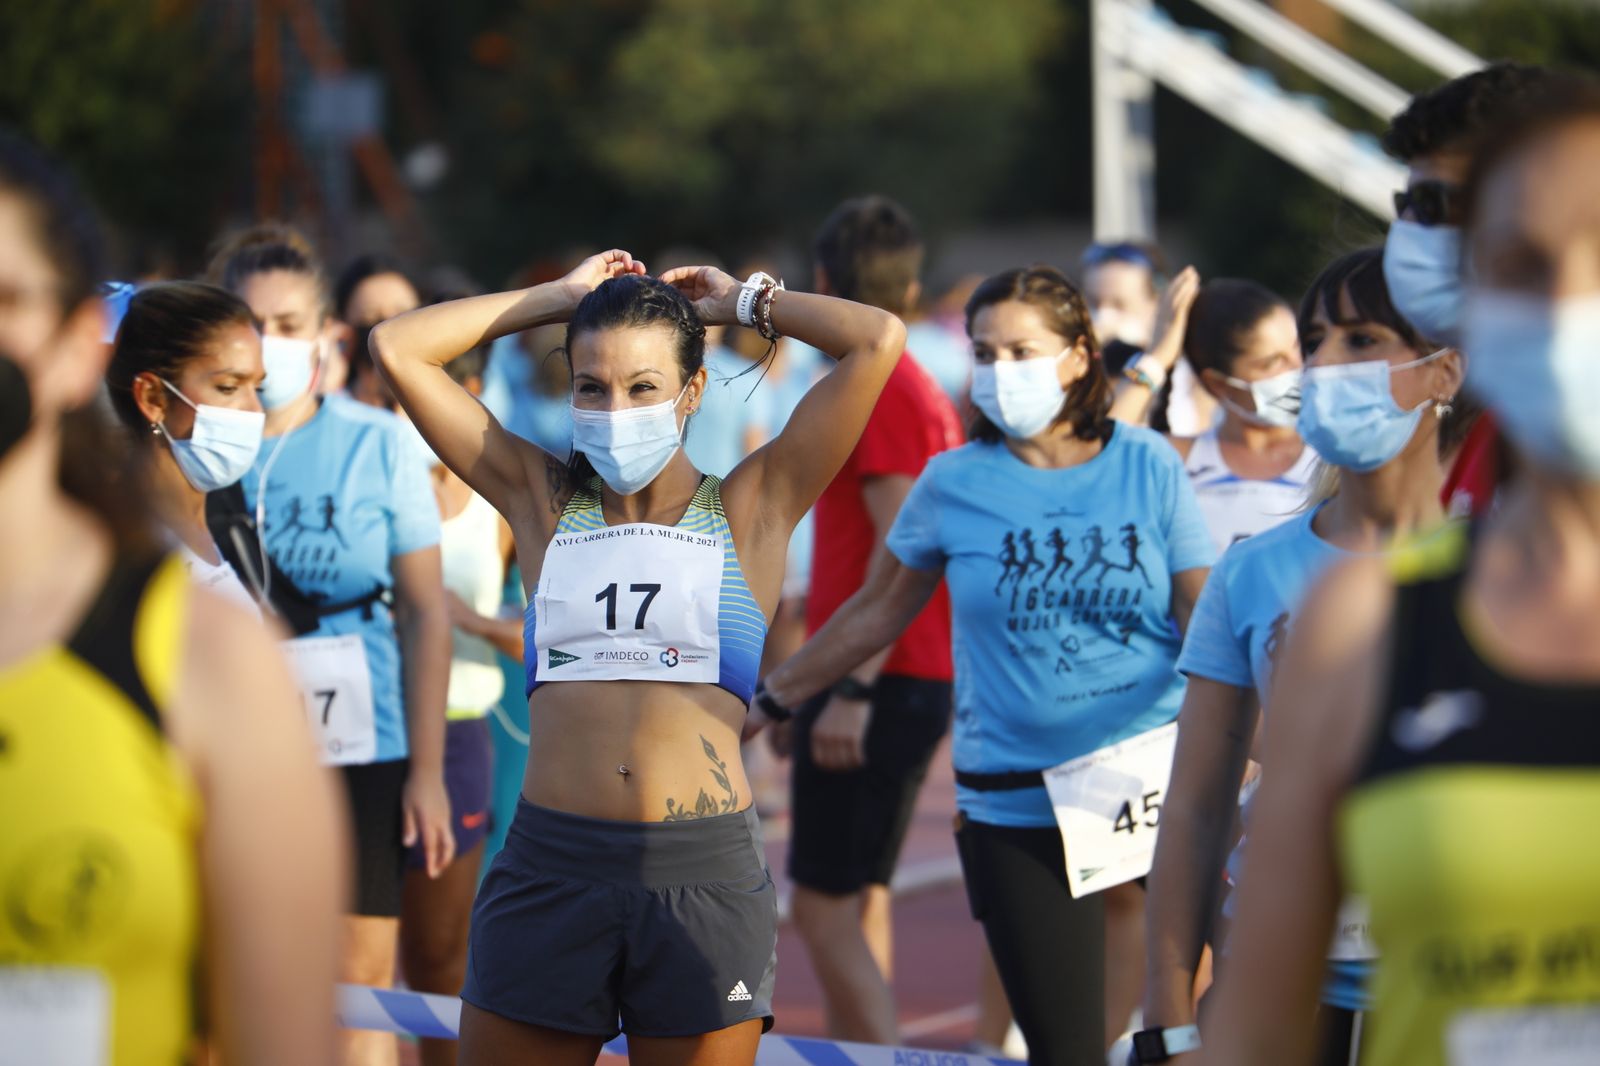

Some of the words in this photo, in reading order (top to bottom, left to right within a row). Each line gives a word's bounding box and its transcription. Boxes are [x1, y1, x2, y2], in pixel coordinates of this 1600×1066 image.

[555, 538, 573, 547] XVI
[575, 530, 621, 544] CARRERA
[623, 528, 638, 536] DE
[640, 528, 654, 536] LA
[657, 530, 694, 543] MUJER
[696, 537, 717, 547] 2021
[595, 583, 662, 630] 17
[1007, 612, 1060, 631] MUJER
[605, 651, 649, 661] IMDECO
[1113, 790, 1162, 834] 45
[728, 993, 752, 1001] adidas
